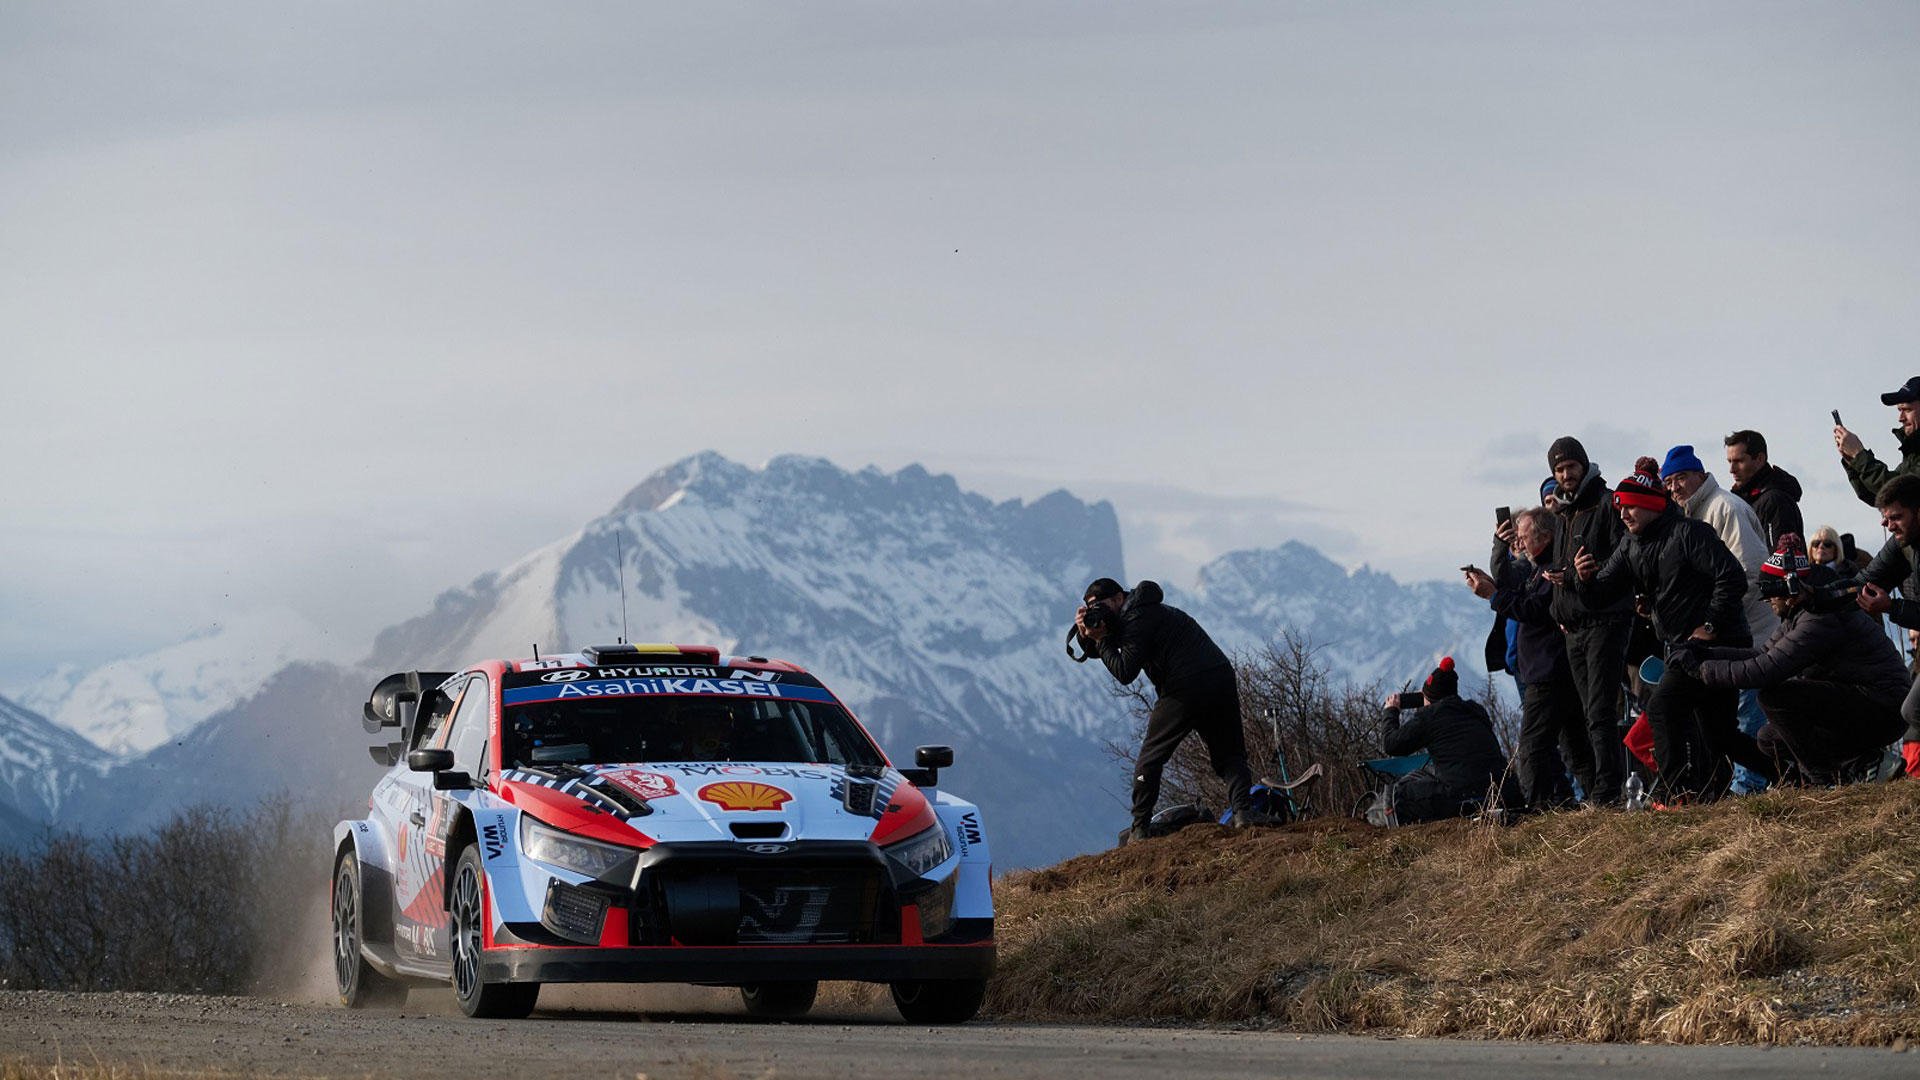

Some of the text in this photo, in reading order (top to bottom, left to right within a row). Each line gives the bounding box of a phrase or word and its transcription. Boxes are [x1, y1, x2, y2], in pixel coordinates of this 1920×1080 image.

[599, 667, 717, 678] HYUNDAI
[652, 762, 756, 770] HYUNDAI
[679, 766, 827, 780] MOBIS
[496, 814, 508, 843] HYUNDAI
[956, 826, 968, 857] HYUNDAI
